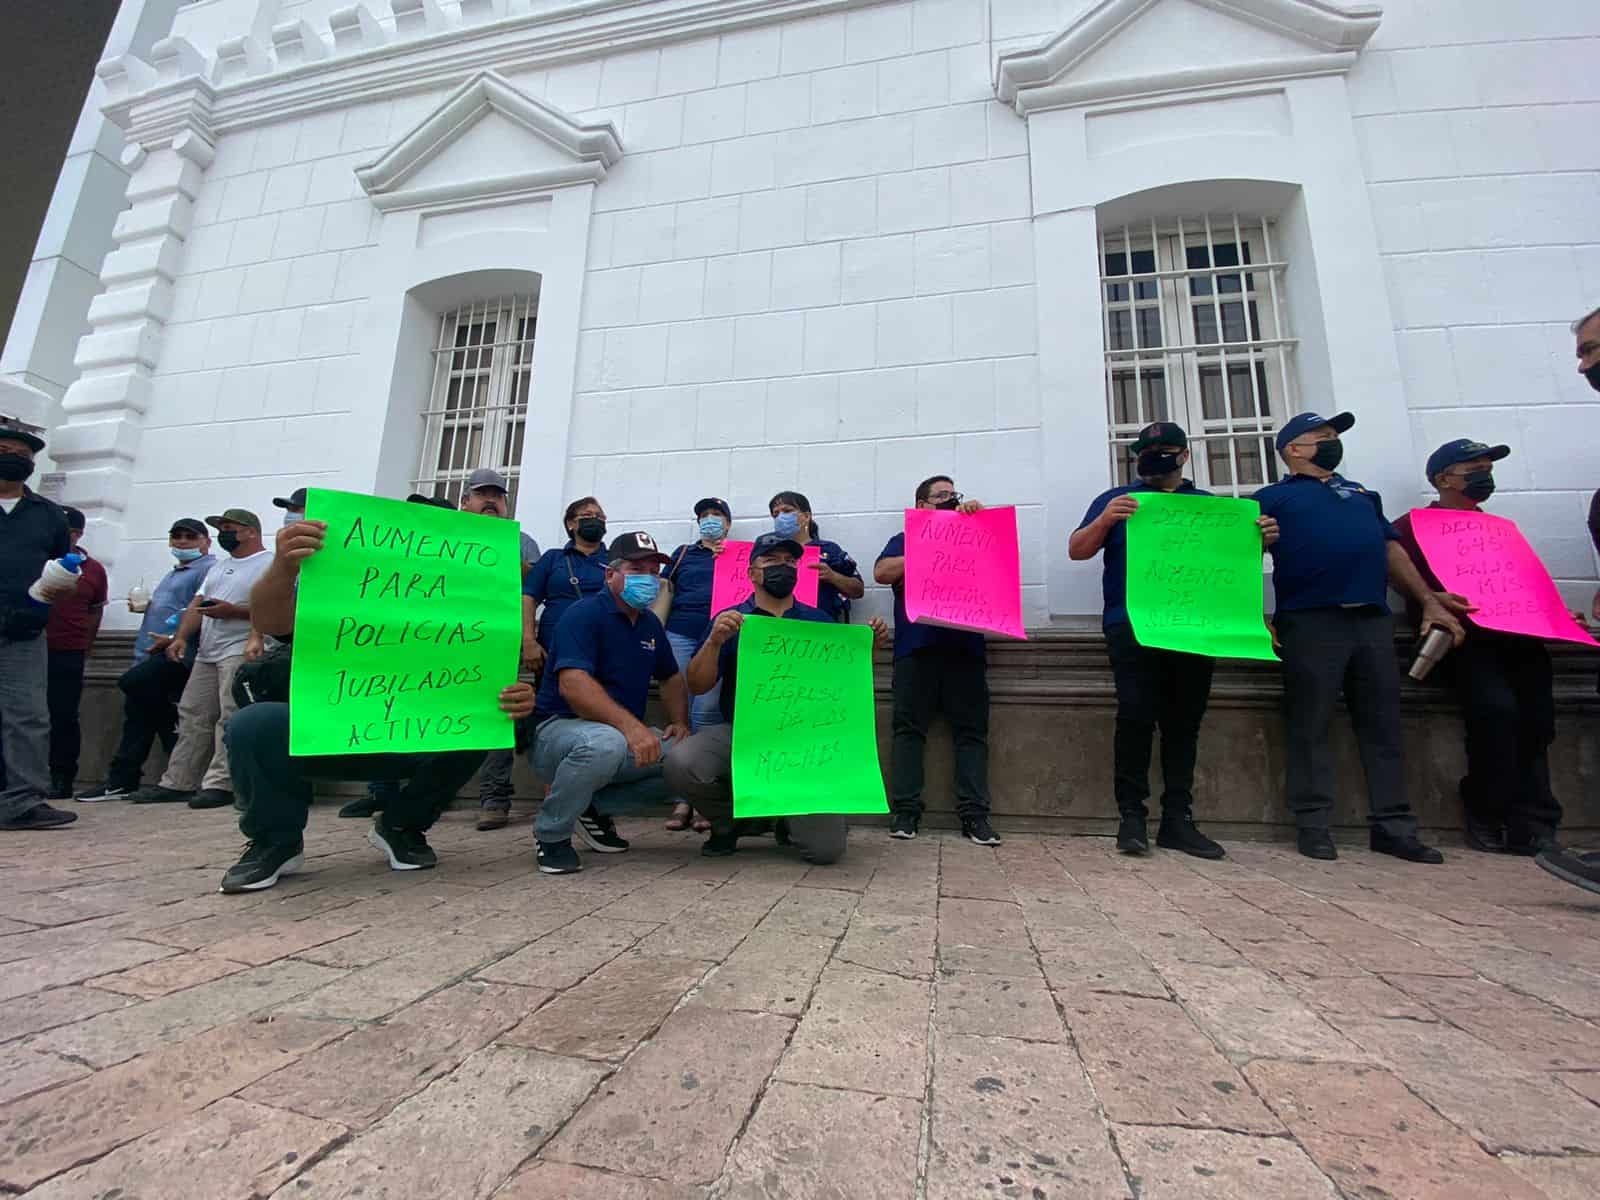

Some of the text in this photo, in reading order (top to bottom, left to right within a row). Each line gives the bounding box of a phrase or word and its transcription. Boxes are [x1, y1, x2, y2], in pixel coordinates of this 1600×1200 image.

[344, 517, 498, 567] AUMENTO
[359, 567, 446, 599] PARA
[335, 616, 486, 650] POLICIAS
[328, 665, 482, 705] JUBILADOS
[384, 695, 395, 721] Y
[348, 714, 472, 747] ACTIVOS
